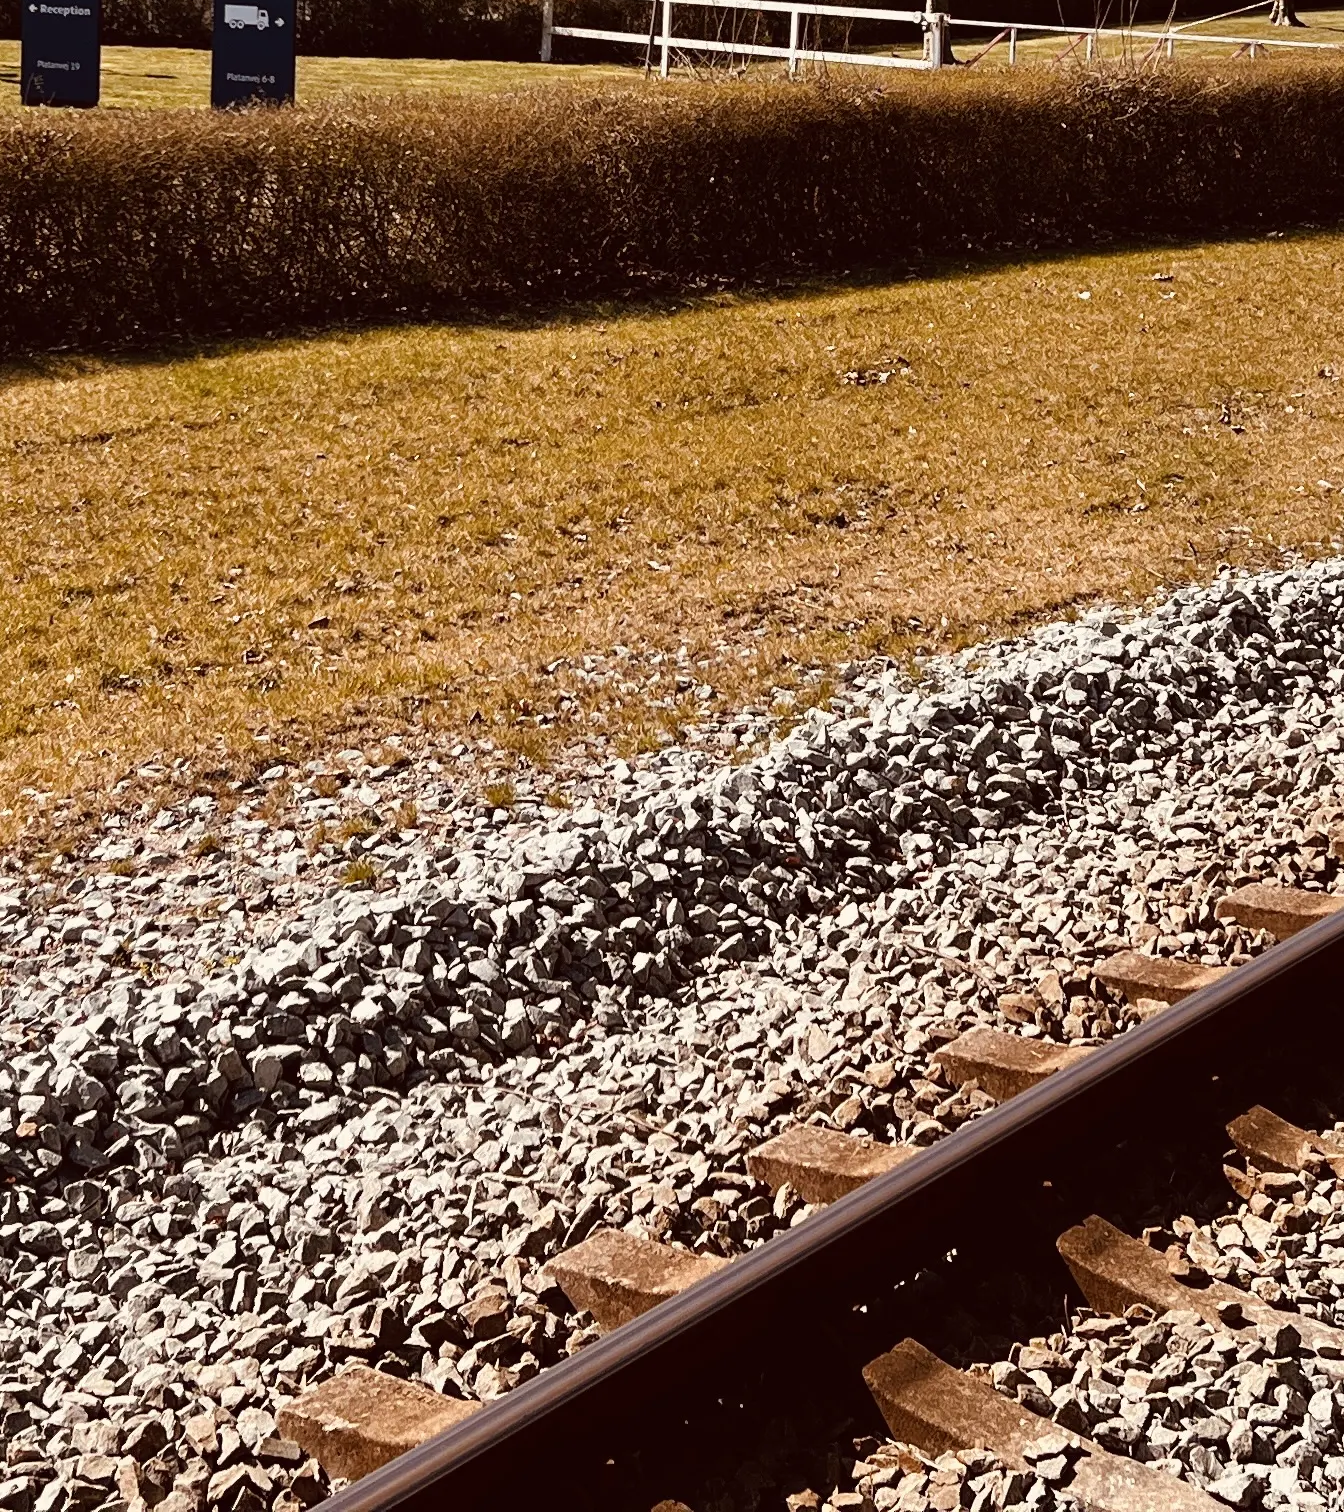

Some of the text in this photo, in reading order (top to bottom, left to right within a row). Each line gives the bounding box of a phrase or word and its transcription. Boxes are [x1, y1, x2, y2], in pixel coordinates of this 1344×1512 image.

[40, 4, 91, 17] Reception
[71, 62, 81, 71] 19
[262, 75, 276, 84] 6-8
